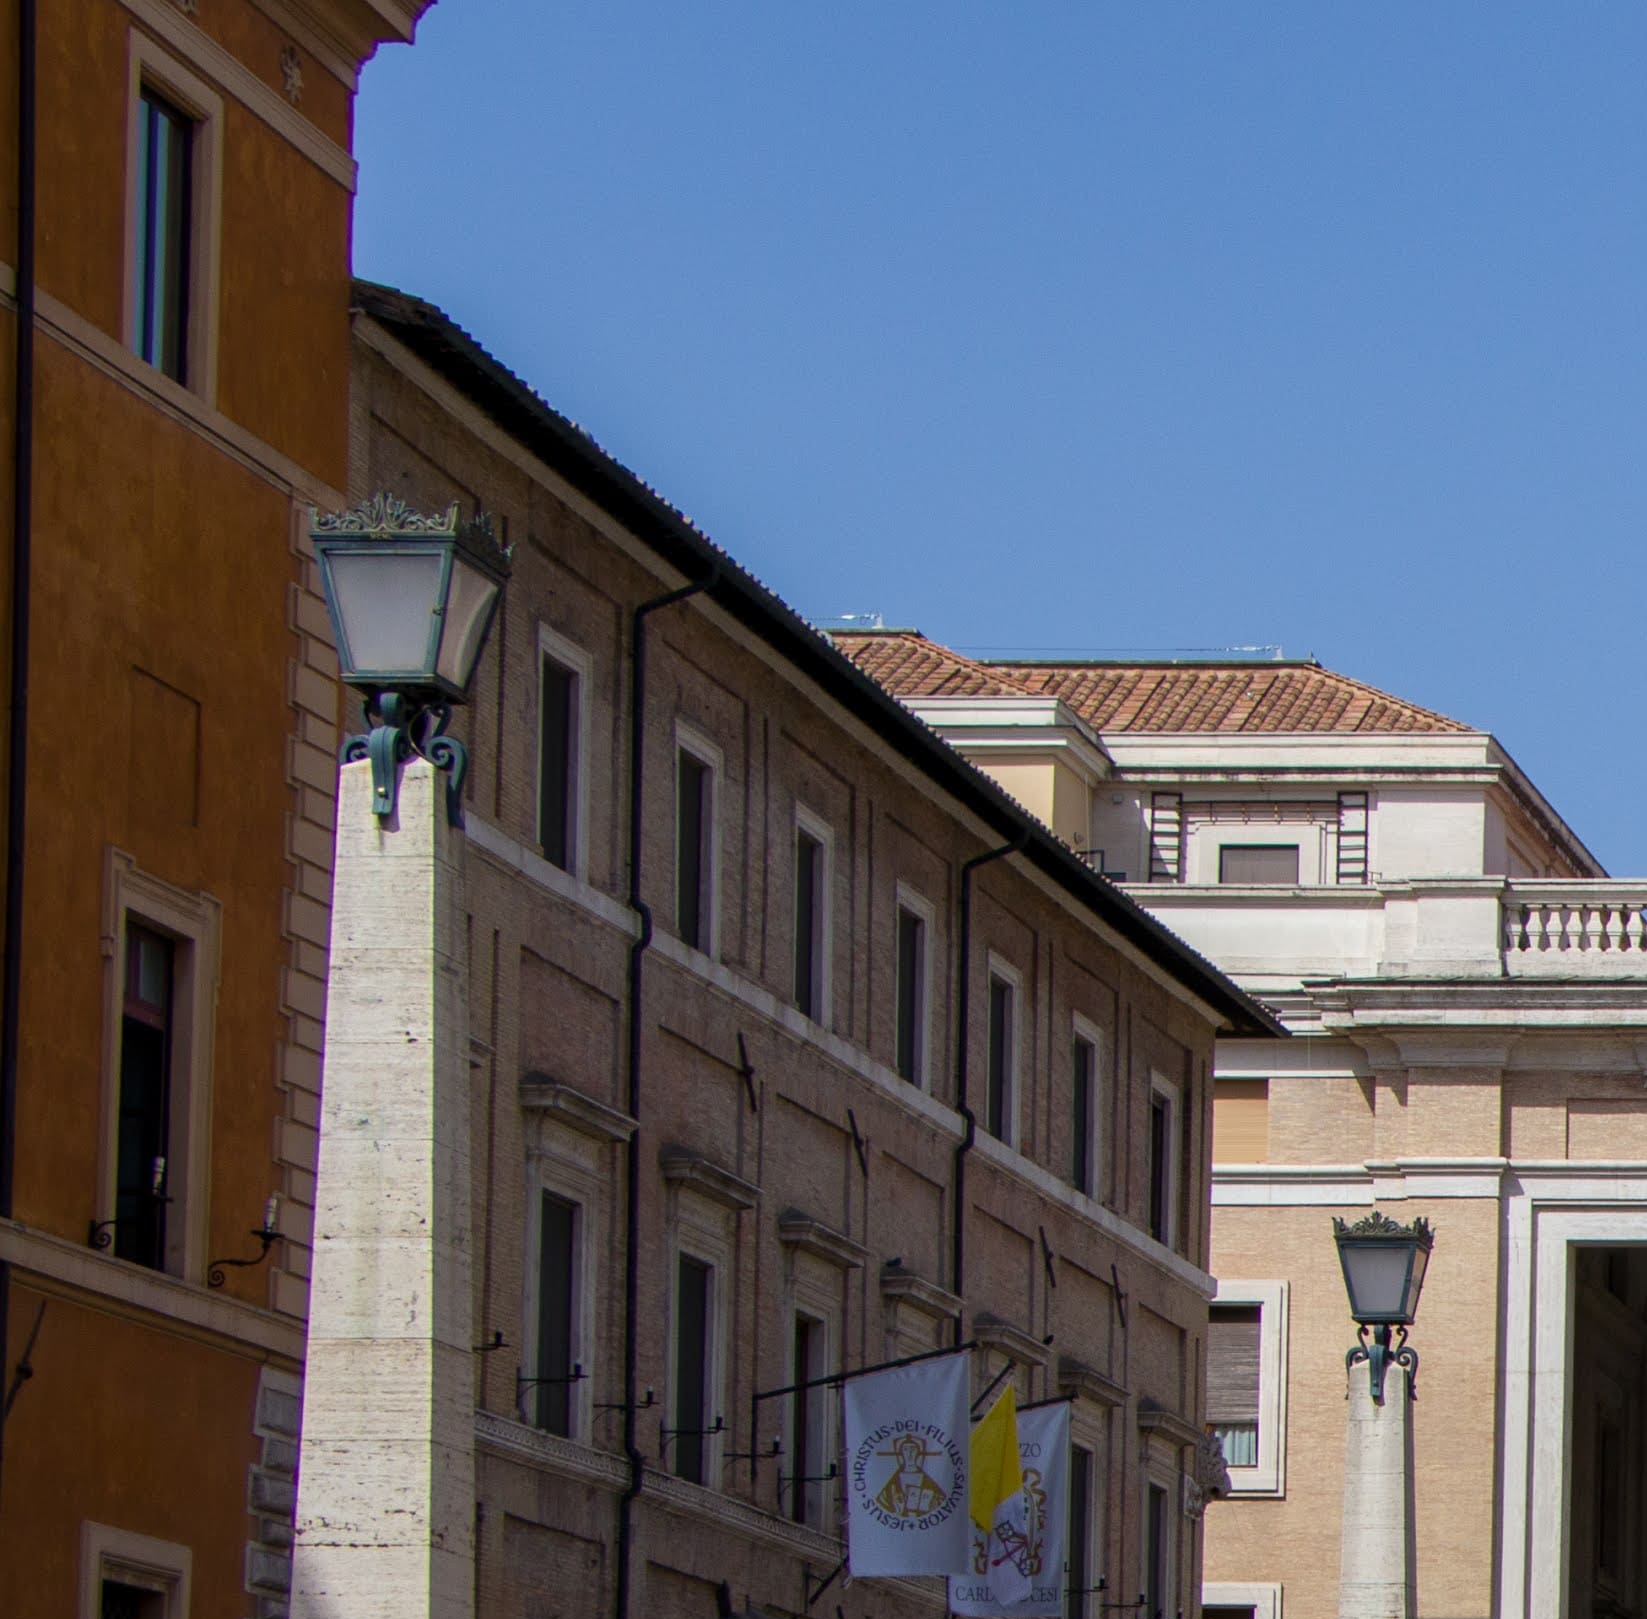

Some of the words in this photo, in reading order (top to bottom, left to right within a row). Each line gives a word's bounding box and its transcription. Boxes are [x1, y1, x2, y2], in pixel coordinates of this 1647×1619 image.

[895, 1419, 919, 1433] DEI
[926, 1424, 963, 1467] FILIUS
[853, 1425, 891, 1492] CHRISTUS
[862, 1498, 905, 1531] JESUS
[919, 1472, 965, 1531] SALVATOR
